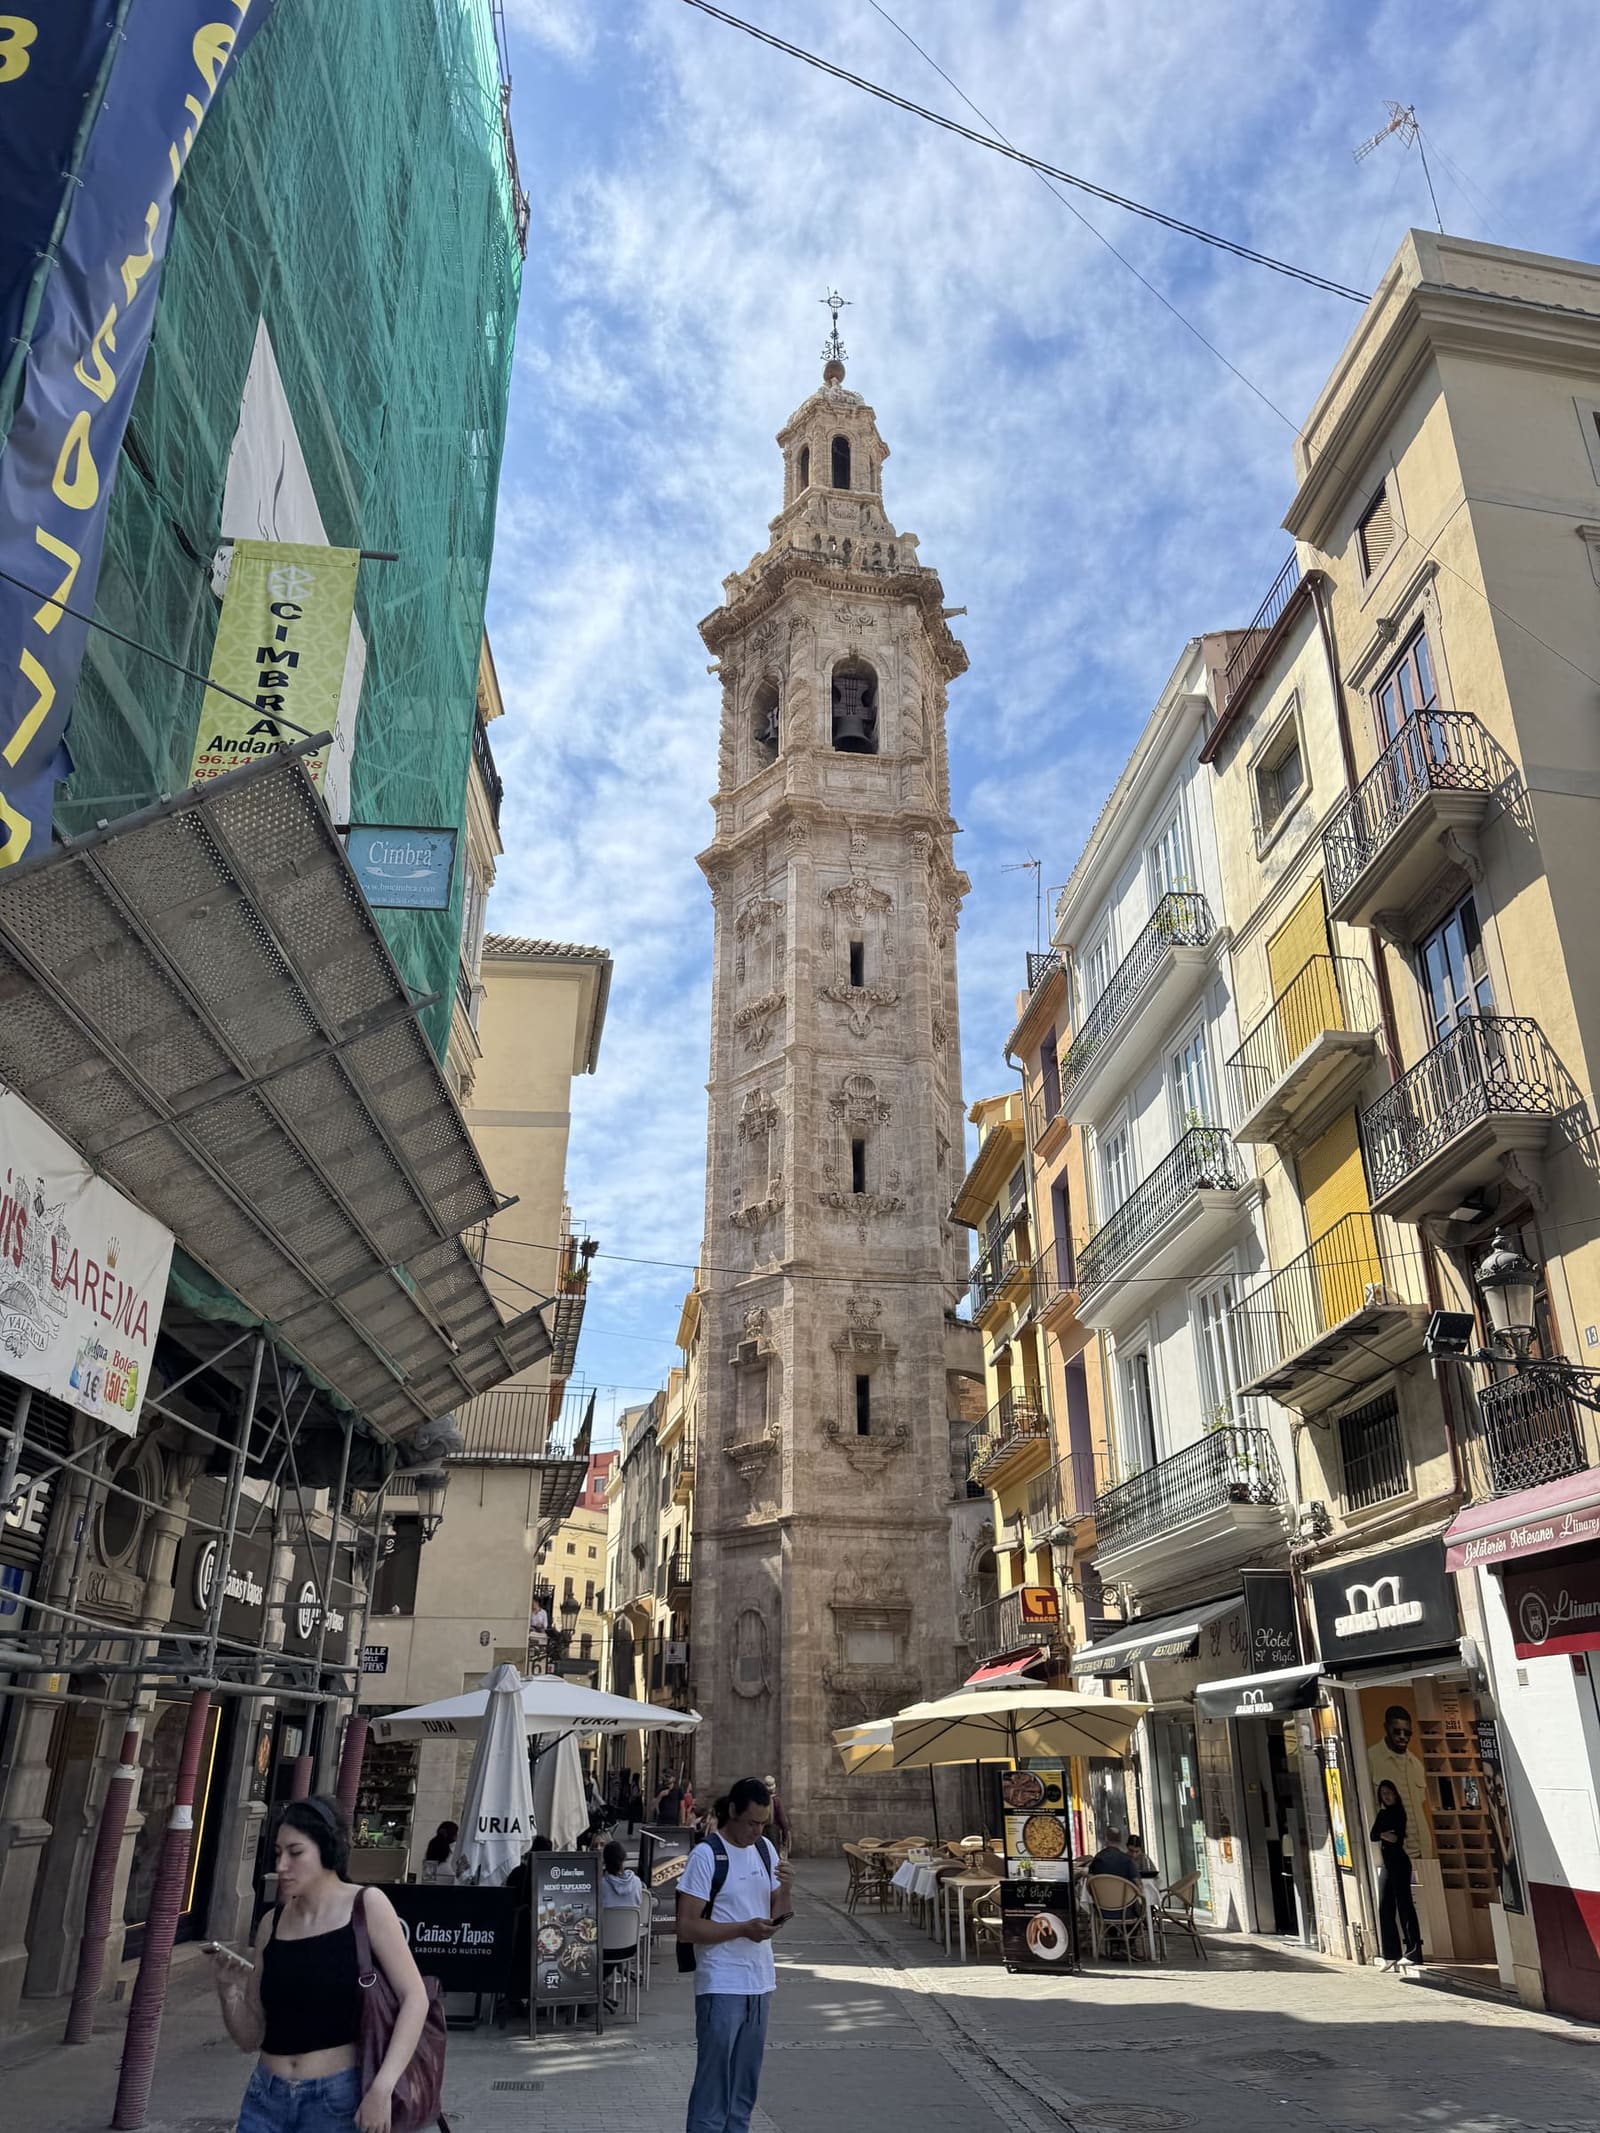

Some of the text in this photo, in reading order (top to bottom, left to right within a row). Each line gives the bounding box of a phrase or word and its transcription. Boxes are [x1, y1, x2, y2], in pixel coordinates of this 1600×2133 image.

[246, 601, 304, 737] CIMBRA
[206, 735, 320, 757] Andams
[369, 840, 432, 867] Cimbra
[7, 1315, 46, 1348] VALENCIA
[1559, 1513, 1600, 1539] Llinares
[1376, 1600, 1423, 1628] WORLD
[1255, 1627, 1293, 1648] Hotel
[362, 1647, 387, 1656] ALLE
[421, 1720, 457, 1734] TURIA
[479, 1816, 522, 1833] URIA
[416, 1921, 495, 1945] Cañas y Tapas
[414, 1946, 446, 1954] SABOREA
